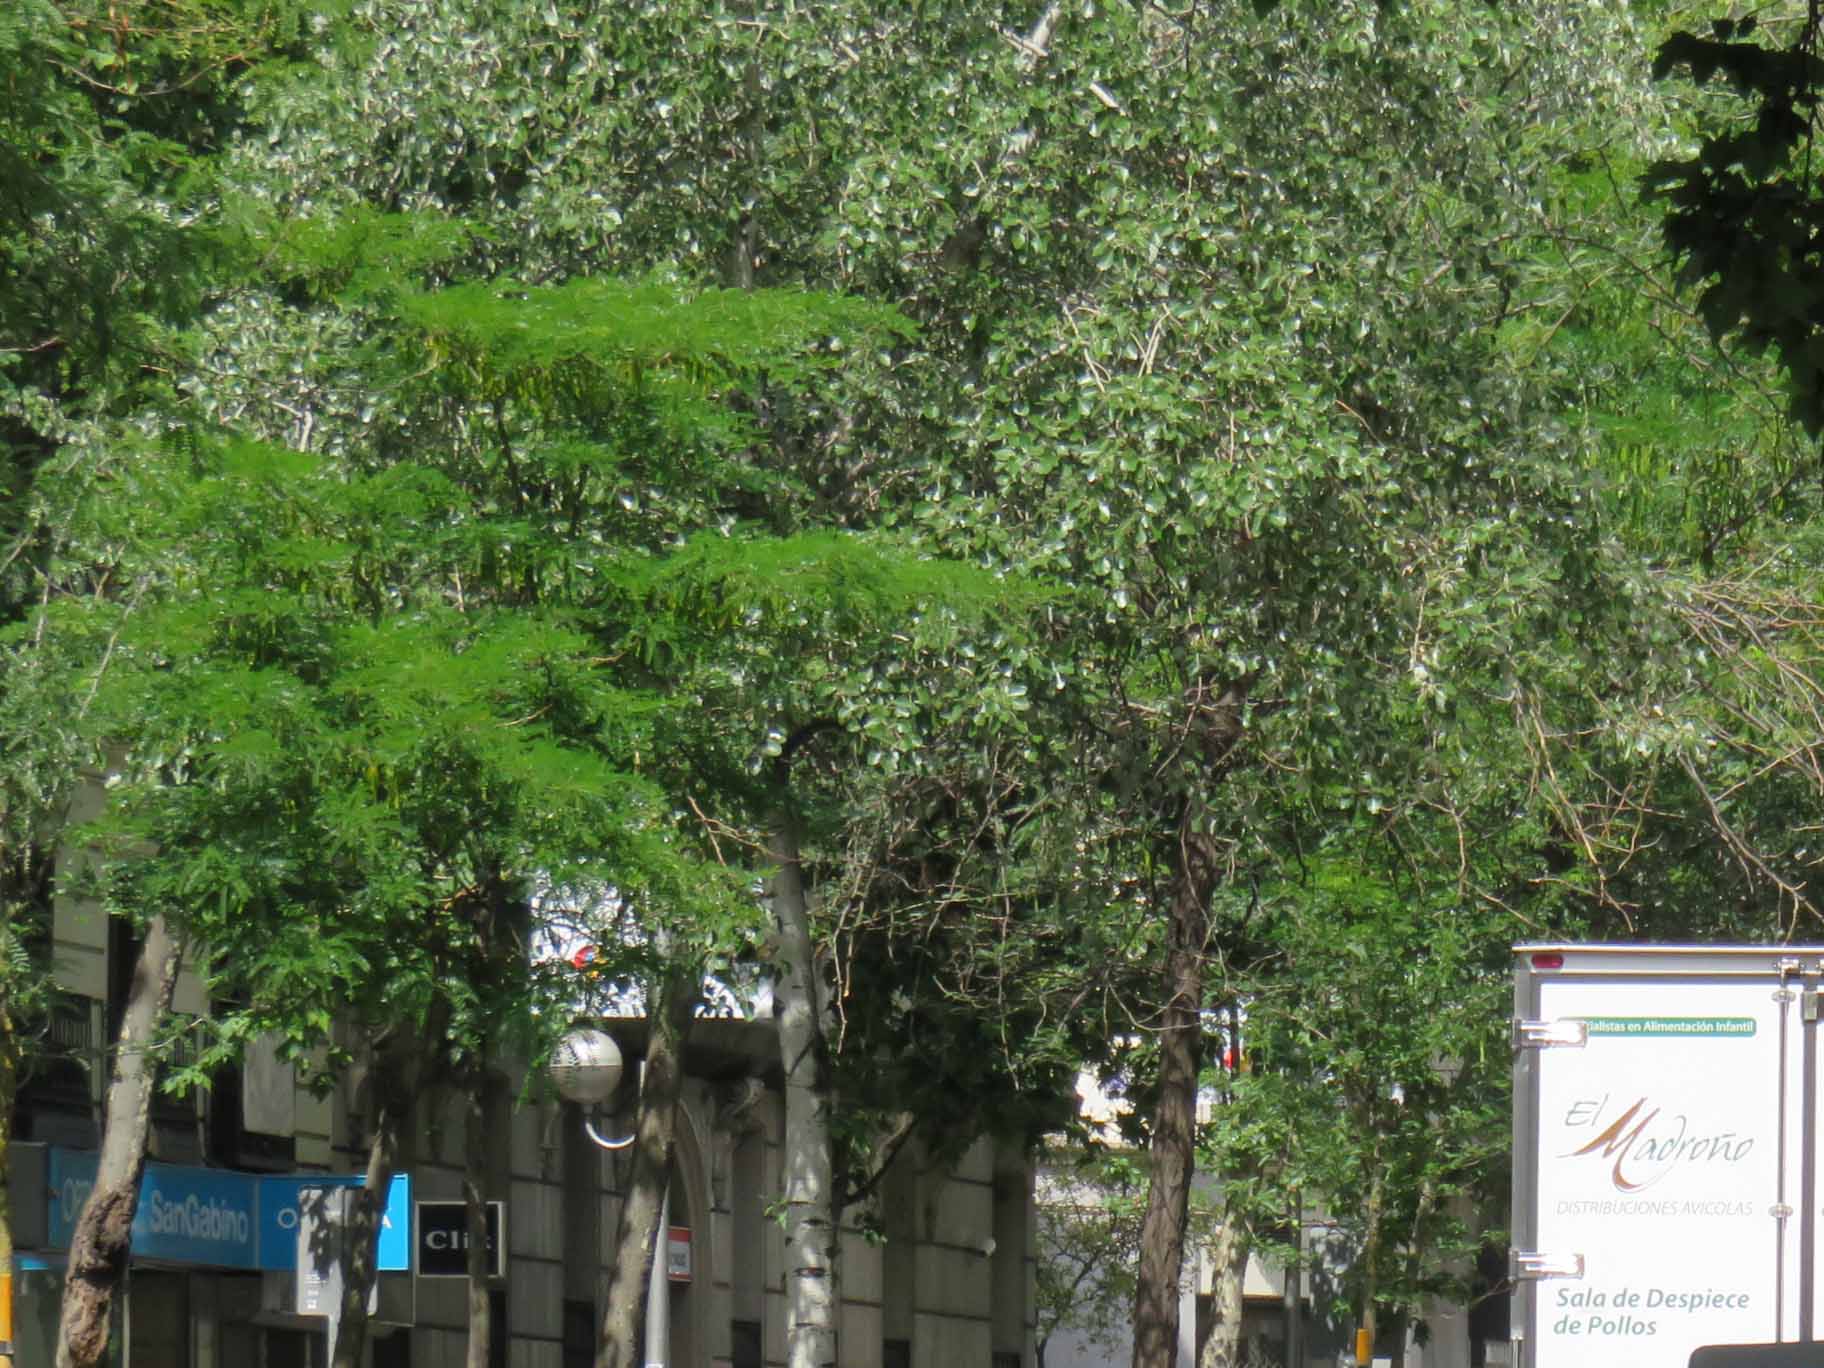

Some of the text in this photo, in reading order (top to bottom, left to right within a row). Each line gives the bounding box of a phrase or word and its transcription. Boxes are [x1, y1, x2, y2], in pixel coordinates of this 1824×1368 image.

[1627, 1023, 1642, 1033] en
[1643, 1020, 1714, 1033] Alimentación
[1716, 1020, 1754, 1033] Infantil
[1564, 1093, 1610, 1127] El
[1556, 1097, 1754, 1194] Madroño
[1556, 1200, 1678, 1216] DISTRIBUCIONES
[1556, 1287, 1750, 1312] Sala de Despiece
[1553, 1314, 1657, 1336] de Pollos
